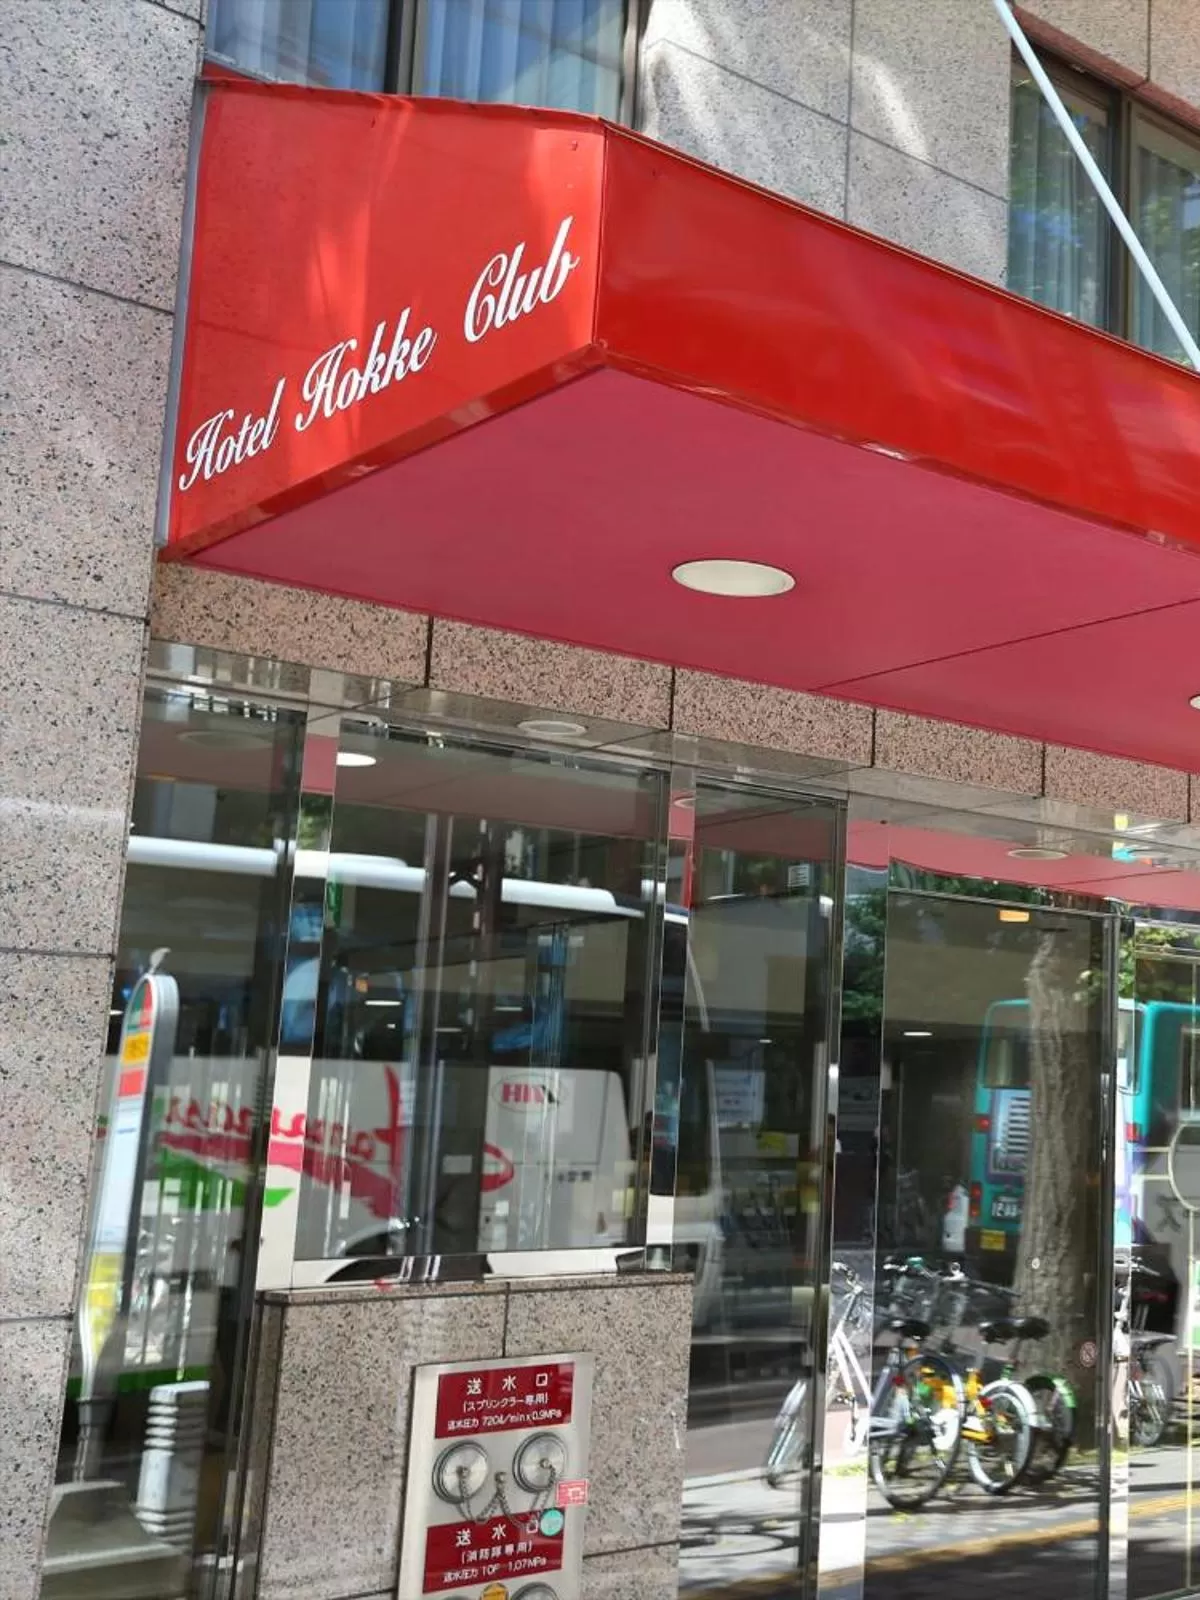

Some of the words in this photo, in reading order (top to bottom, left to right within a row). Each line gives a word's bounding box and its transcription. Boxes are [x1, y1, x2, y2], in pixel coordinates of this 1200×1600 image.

[179, 377, 286, 491] Hotel
[294, 307, 438, 432] Hokke
[463, 216, 580, 344] Club
[466, 1372, 548, 1396] 送水口
